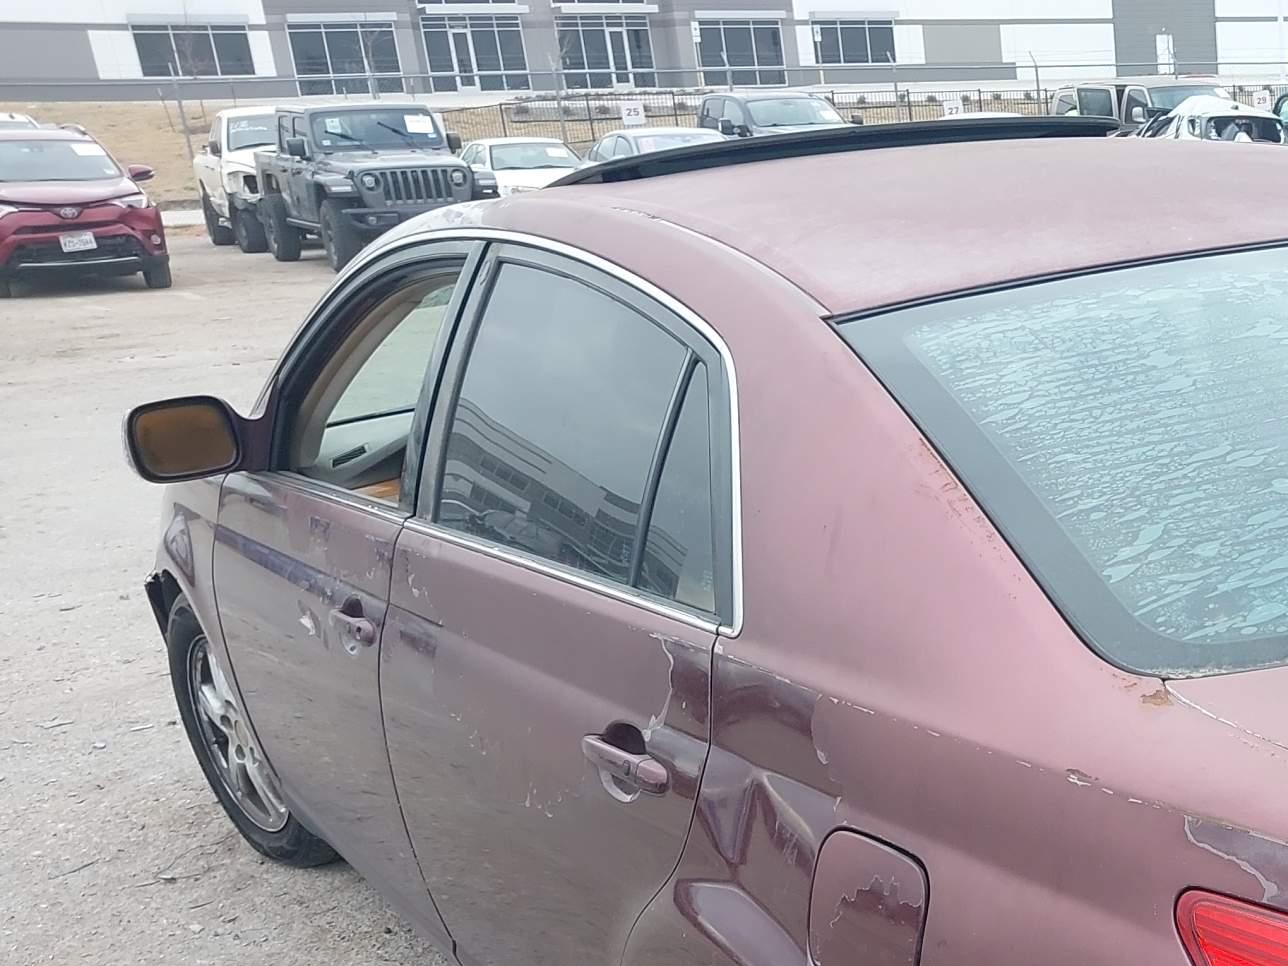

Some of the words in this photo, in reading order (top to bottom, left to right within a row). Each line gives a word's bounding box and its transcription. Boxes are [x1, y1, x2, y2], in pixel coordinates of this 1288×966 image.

[1256, 96, 1267, 105] 29
[626, 107, 640, 117] 25
[947, 106, 959, 115] 27
